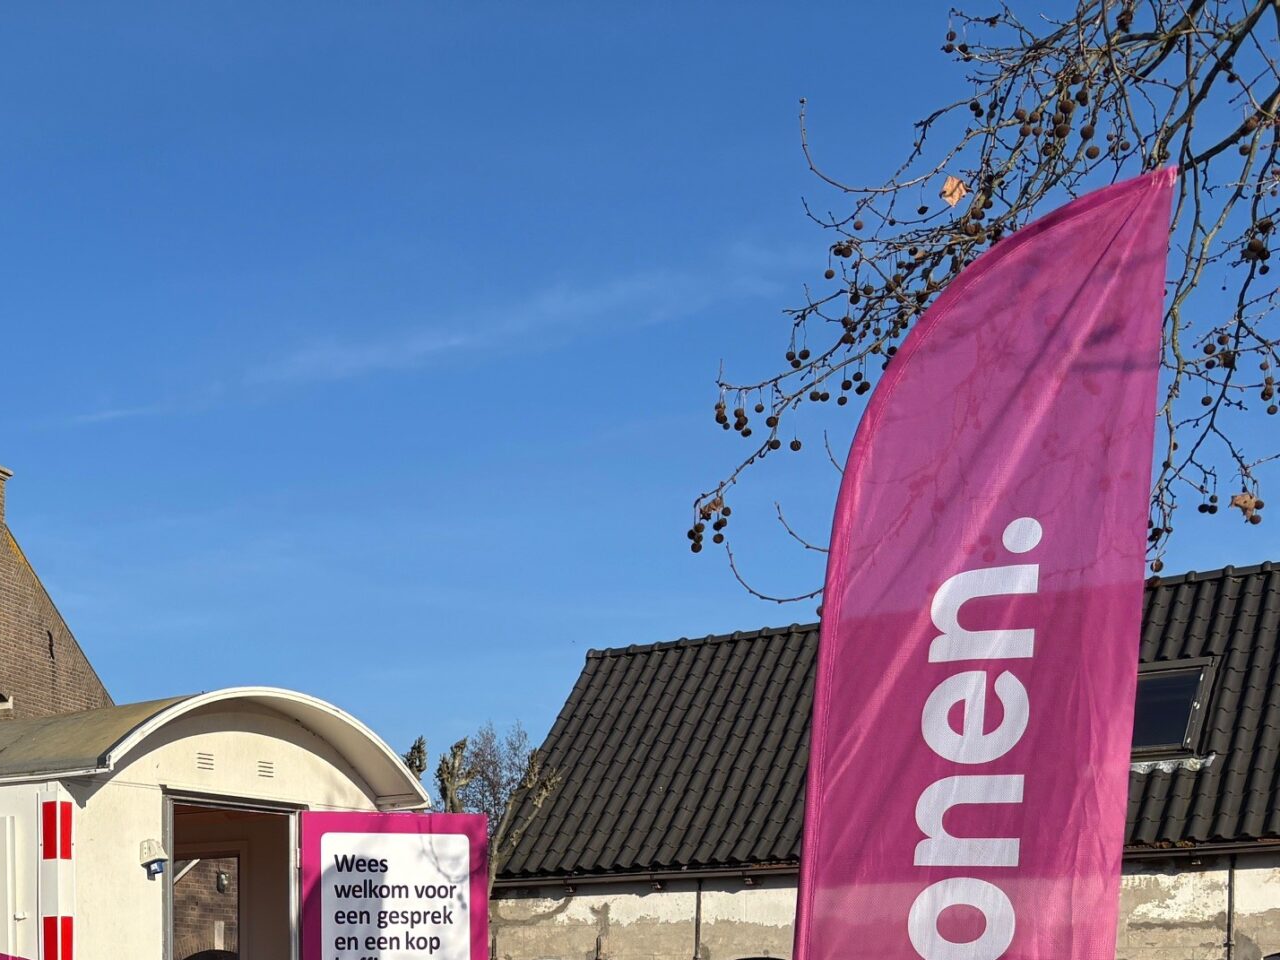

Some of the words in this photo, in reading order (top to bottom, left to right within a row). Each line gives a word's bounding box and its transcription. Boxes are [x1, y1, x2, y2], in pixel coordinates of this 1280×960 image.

[334, 854, 388, 873] Wees
[334, 879, 409, 899] welkom
[414, 885, 457, 899] voor
[334, 910, 370, 925] een
[377, 905, 453, 929] gesprek
[334, 936, 358, 950] en
[364, 936, 400, 950] een
[405, 931, 441, 954] kop
